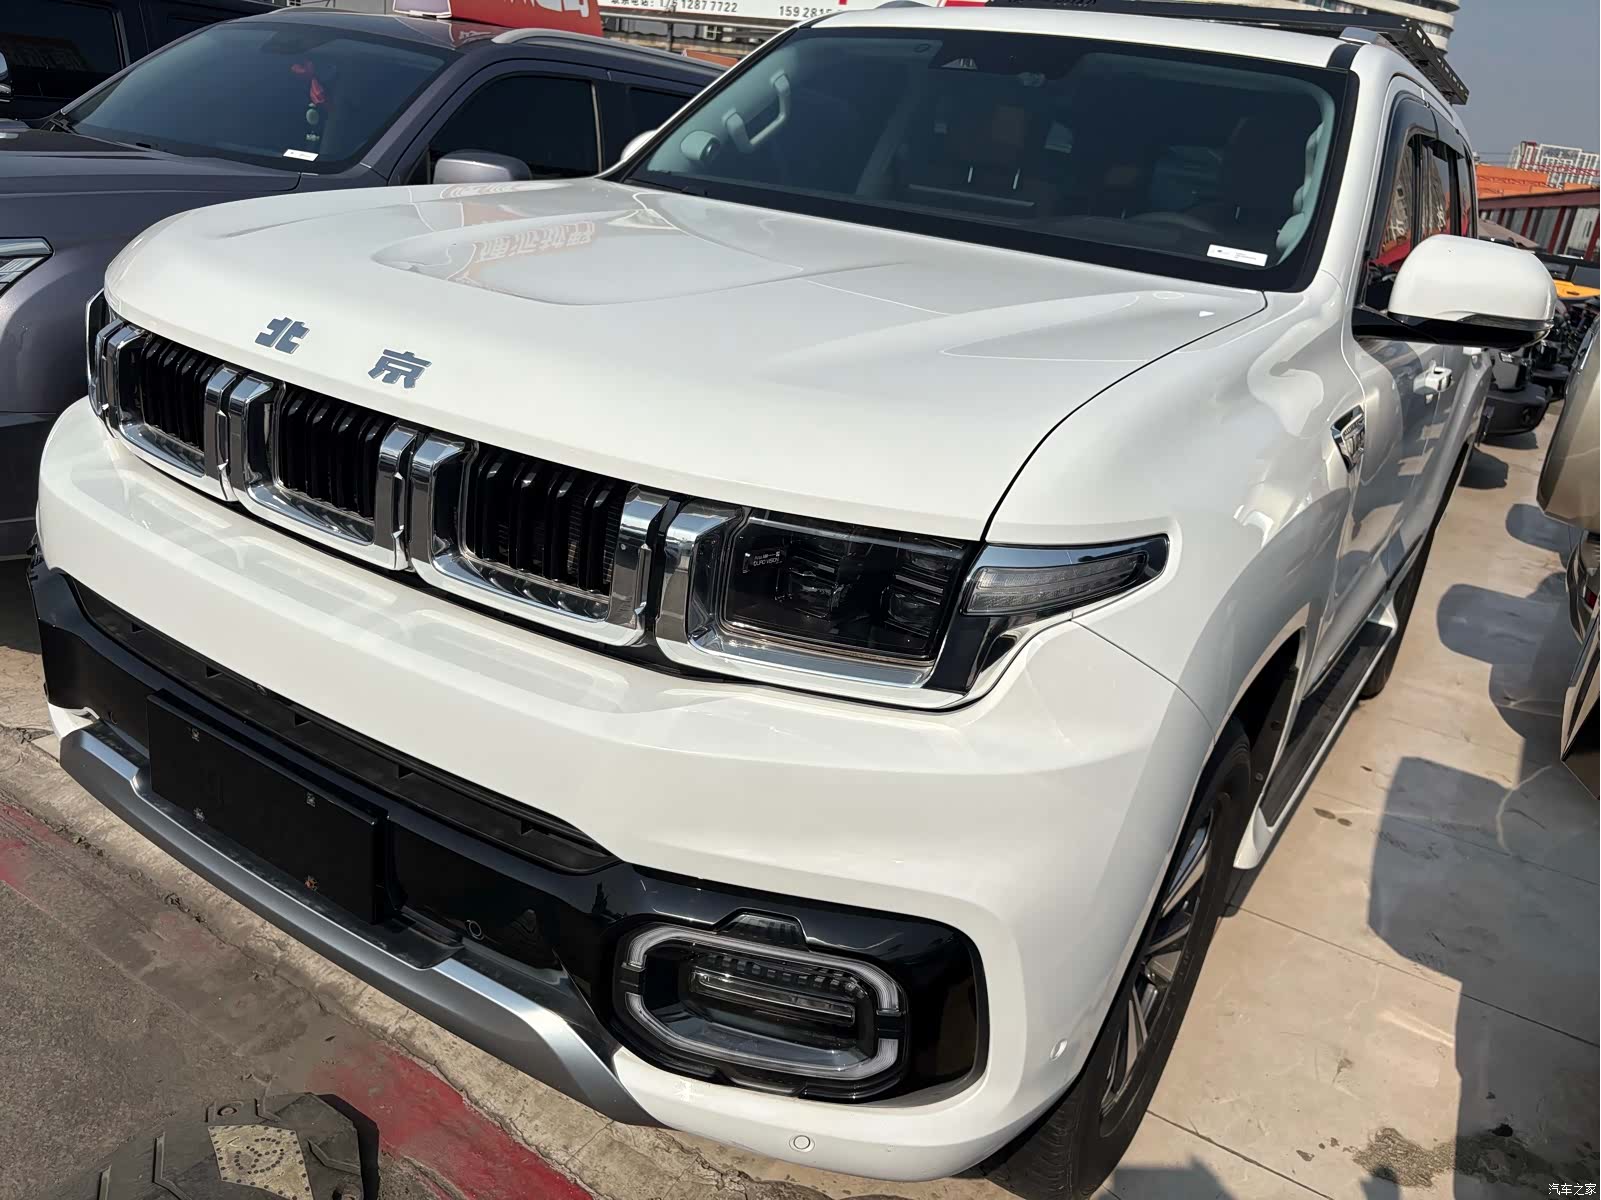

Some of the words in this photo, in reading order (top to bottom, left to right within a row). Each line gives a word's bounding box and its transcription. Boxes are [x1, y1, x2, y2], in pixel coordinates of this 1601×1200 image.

[681, 0, 706, 10] 1287
[710, 2, 738, 13] 7722
[779, 6, 800, 17] 159
